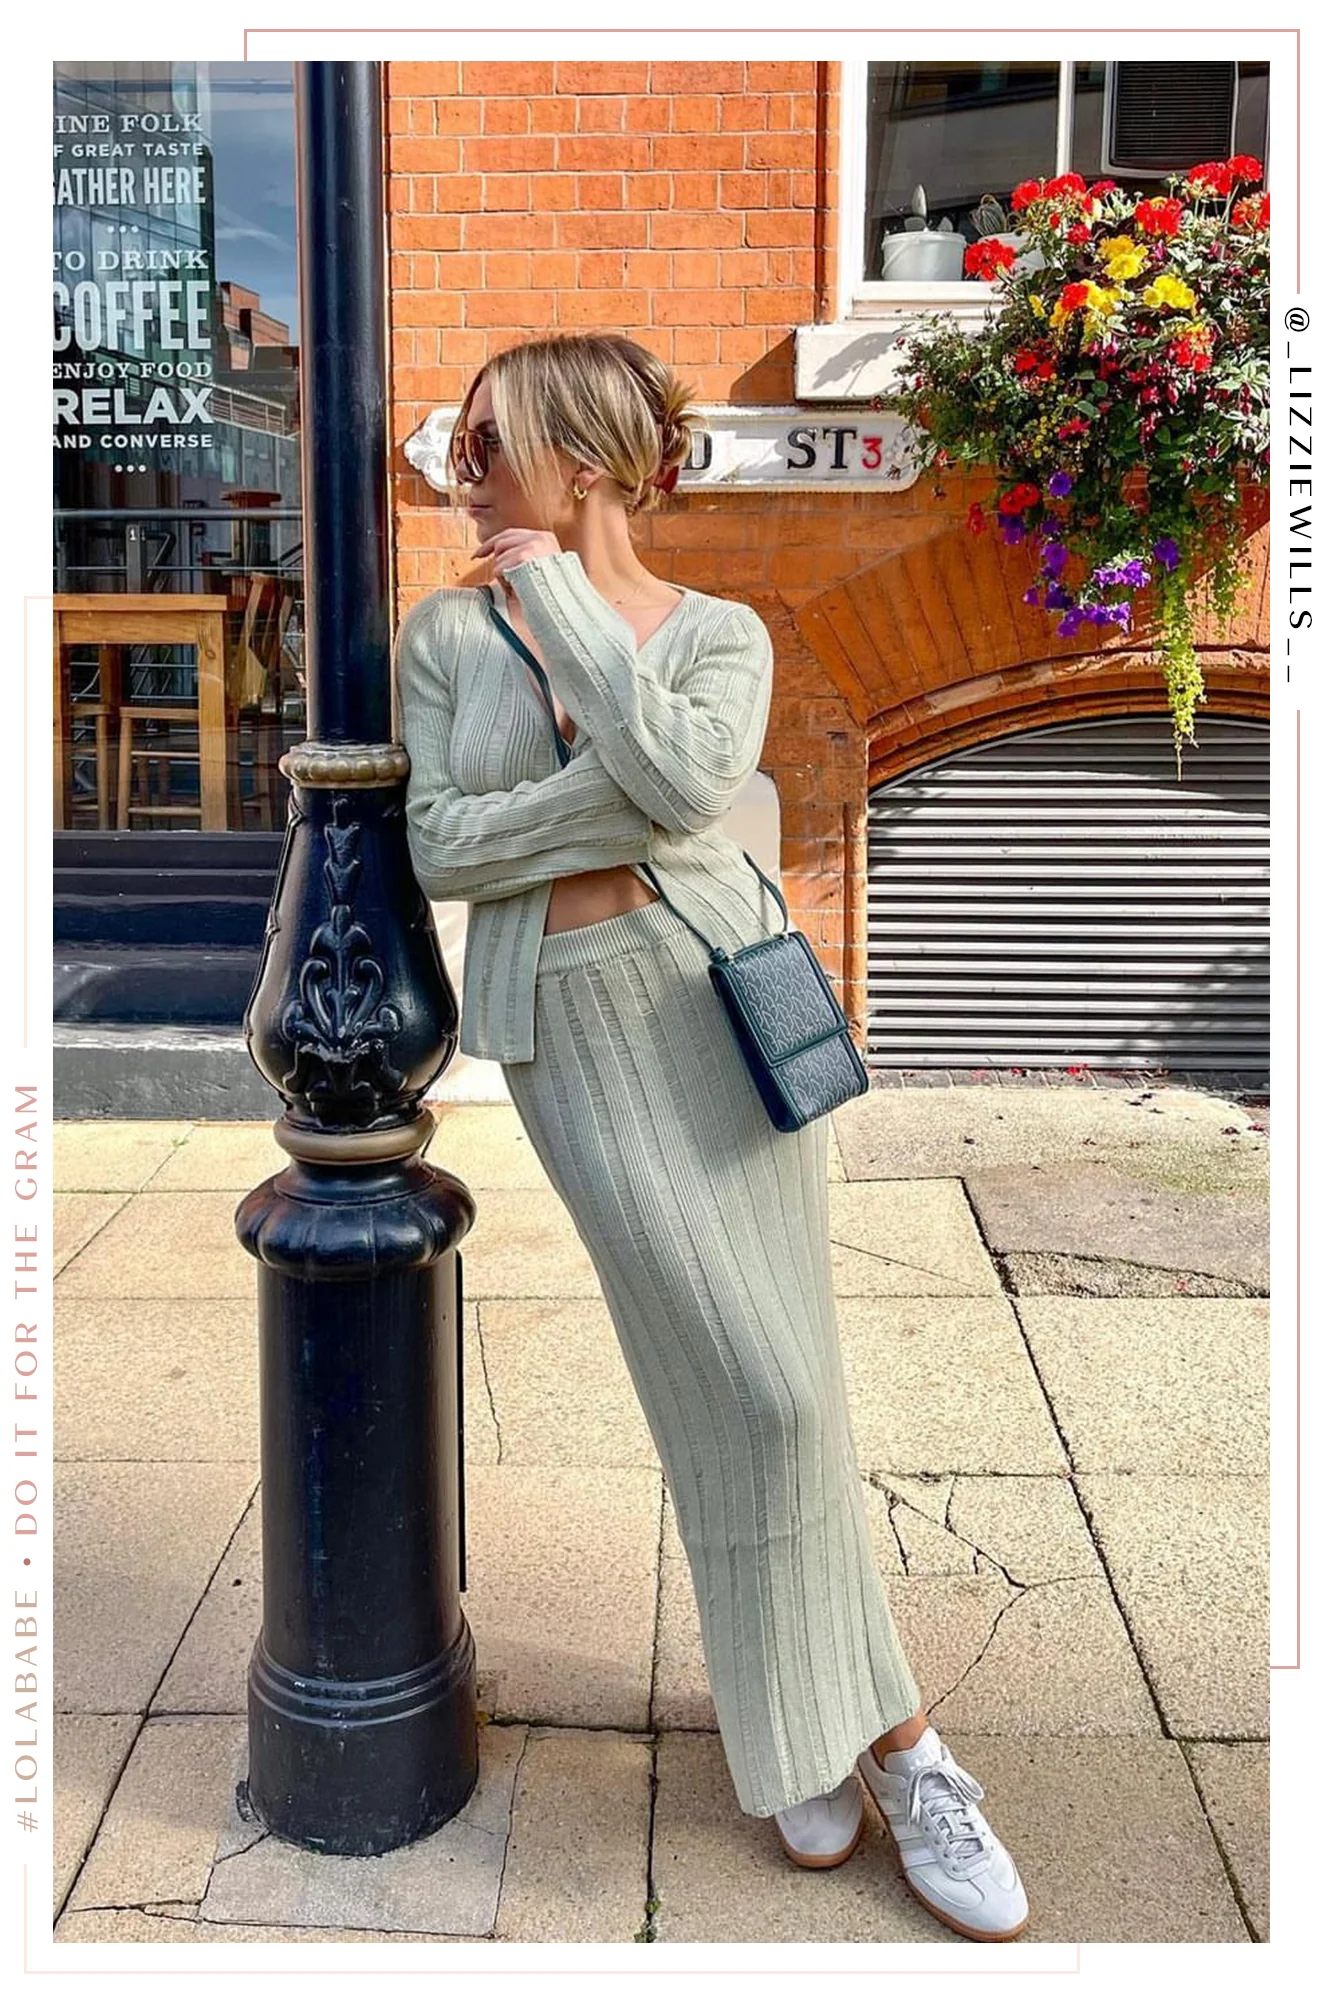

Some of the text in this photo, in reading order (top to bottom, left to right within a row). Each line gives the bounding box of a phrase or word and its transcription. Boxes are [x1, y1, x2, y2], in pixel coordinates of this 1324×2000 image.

[53, 113, 204, 133] INE FOLK
[71, 143, 135, 157] GREAT
[142, 142, 204, 156] TASTE
[143, 166, 206, 205] HERE
[97, 250, 209, 270] DRINK
[53, 280, 212, 352] COFFEE
[53, 361, 213, 379] ENJOY FOOD
[53, 387, 215, 425] RELAX
[53, 434, 213, 449] AND CONVERSE
